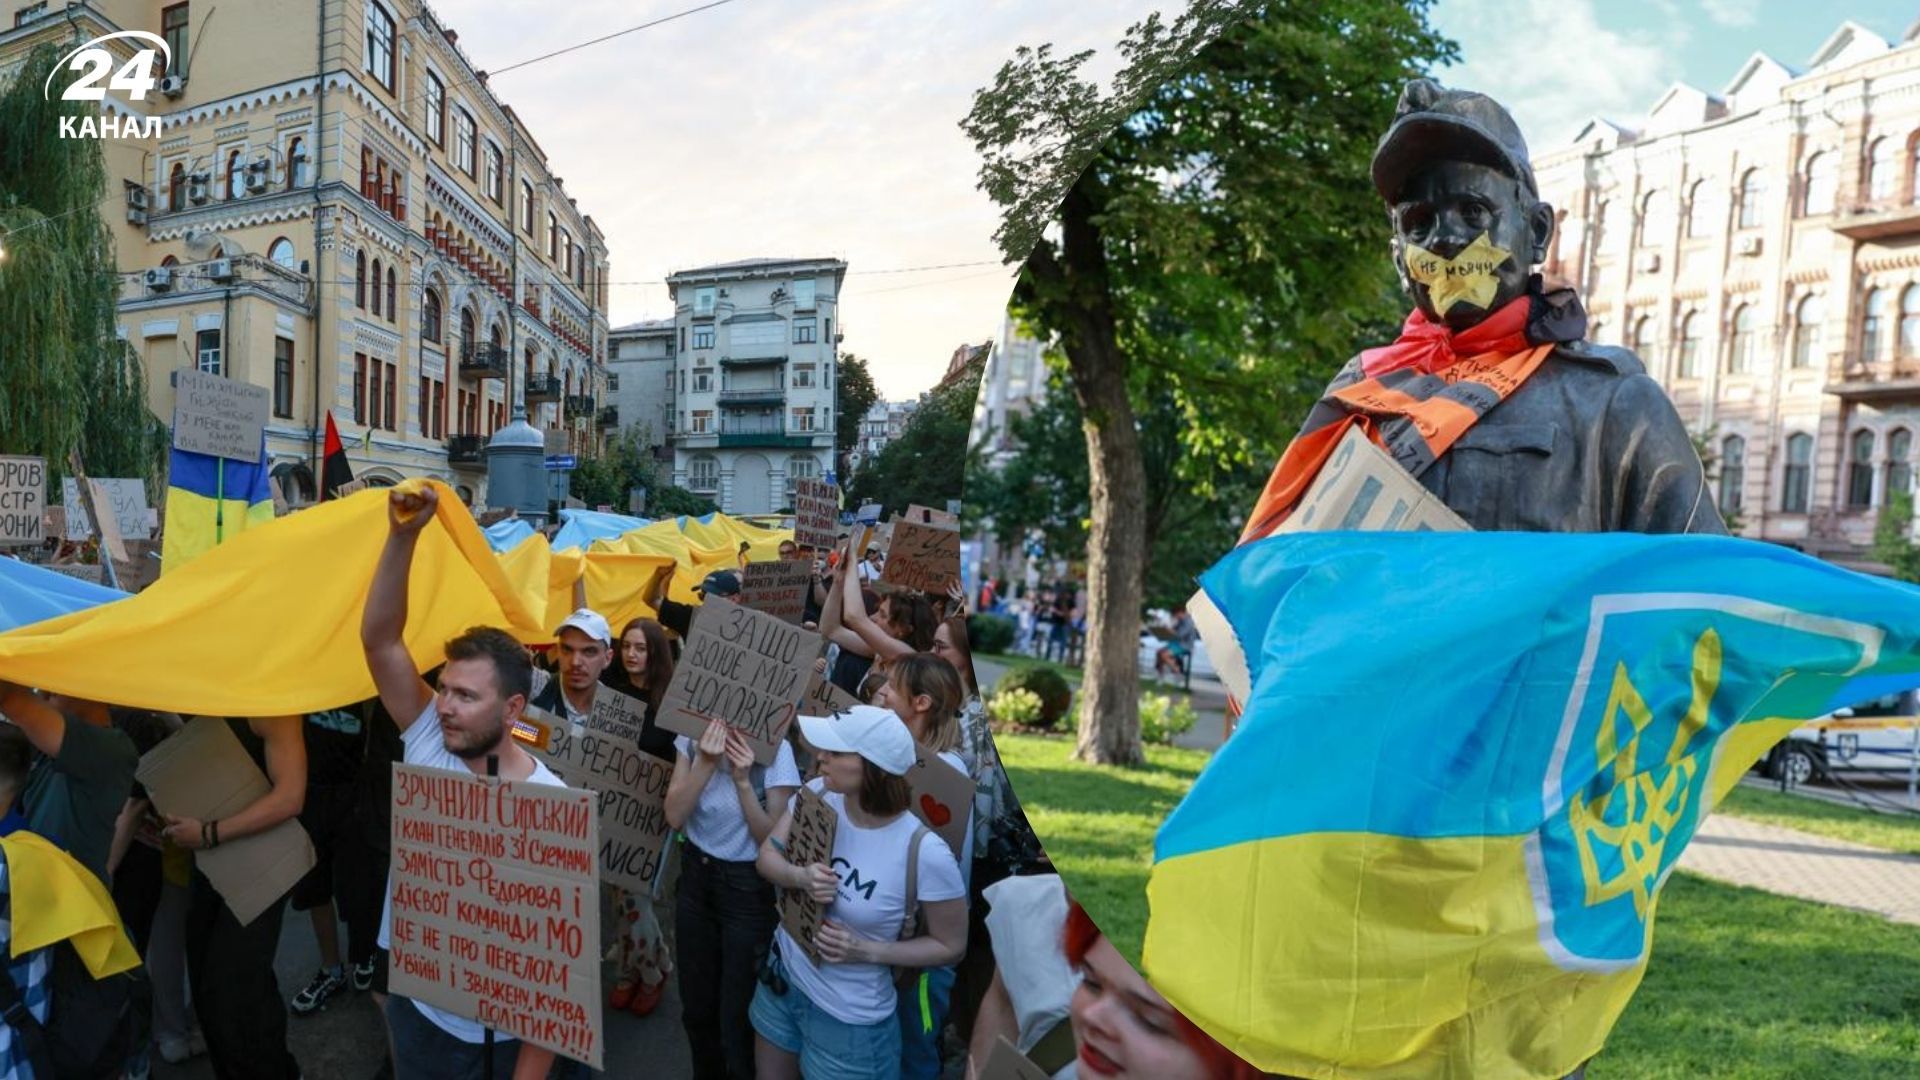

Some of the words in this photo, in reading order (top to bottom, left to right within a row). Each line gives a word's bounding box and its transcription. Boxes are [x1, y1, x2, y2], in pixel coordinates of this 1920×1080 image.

[1, 491, 36, 511] СТР
[719, 607, 757, 650] ЗА
[690, 635, 747, 681] ВОЮЄ
[751, 658, 798, 701] МІЙ
[682, 670, 795, 746] ЧОЛОВІК?
[546, 725, 573, 761] ЗА
[395, 770, 490, 824] ЗРУЧНИЙ
[402, 818, 434, 844] КЛАН
[396, 847, 465, 887] ЗАМІСТЬ
[468, 857, 562, 912] ФЕДОРОВА
[394, 917, 416, 945] ЦЕ
[422, 925, 441, 950] НЕ
[449, 934, 479, 962] ПРО
[485, 943, 570, 992] ПЕРЕЛОМ
[457, 900, 539, 944] КОМАНДИ
[546, 916, 583, 960] МО
[478, 999, 594, 1061] ПОЛІТИКУ!!!
